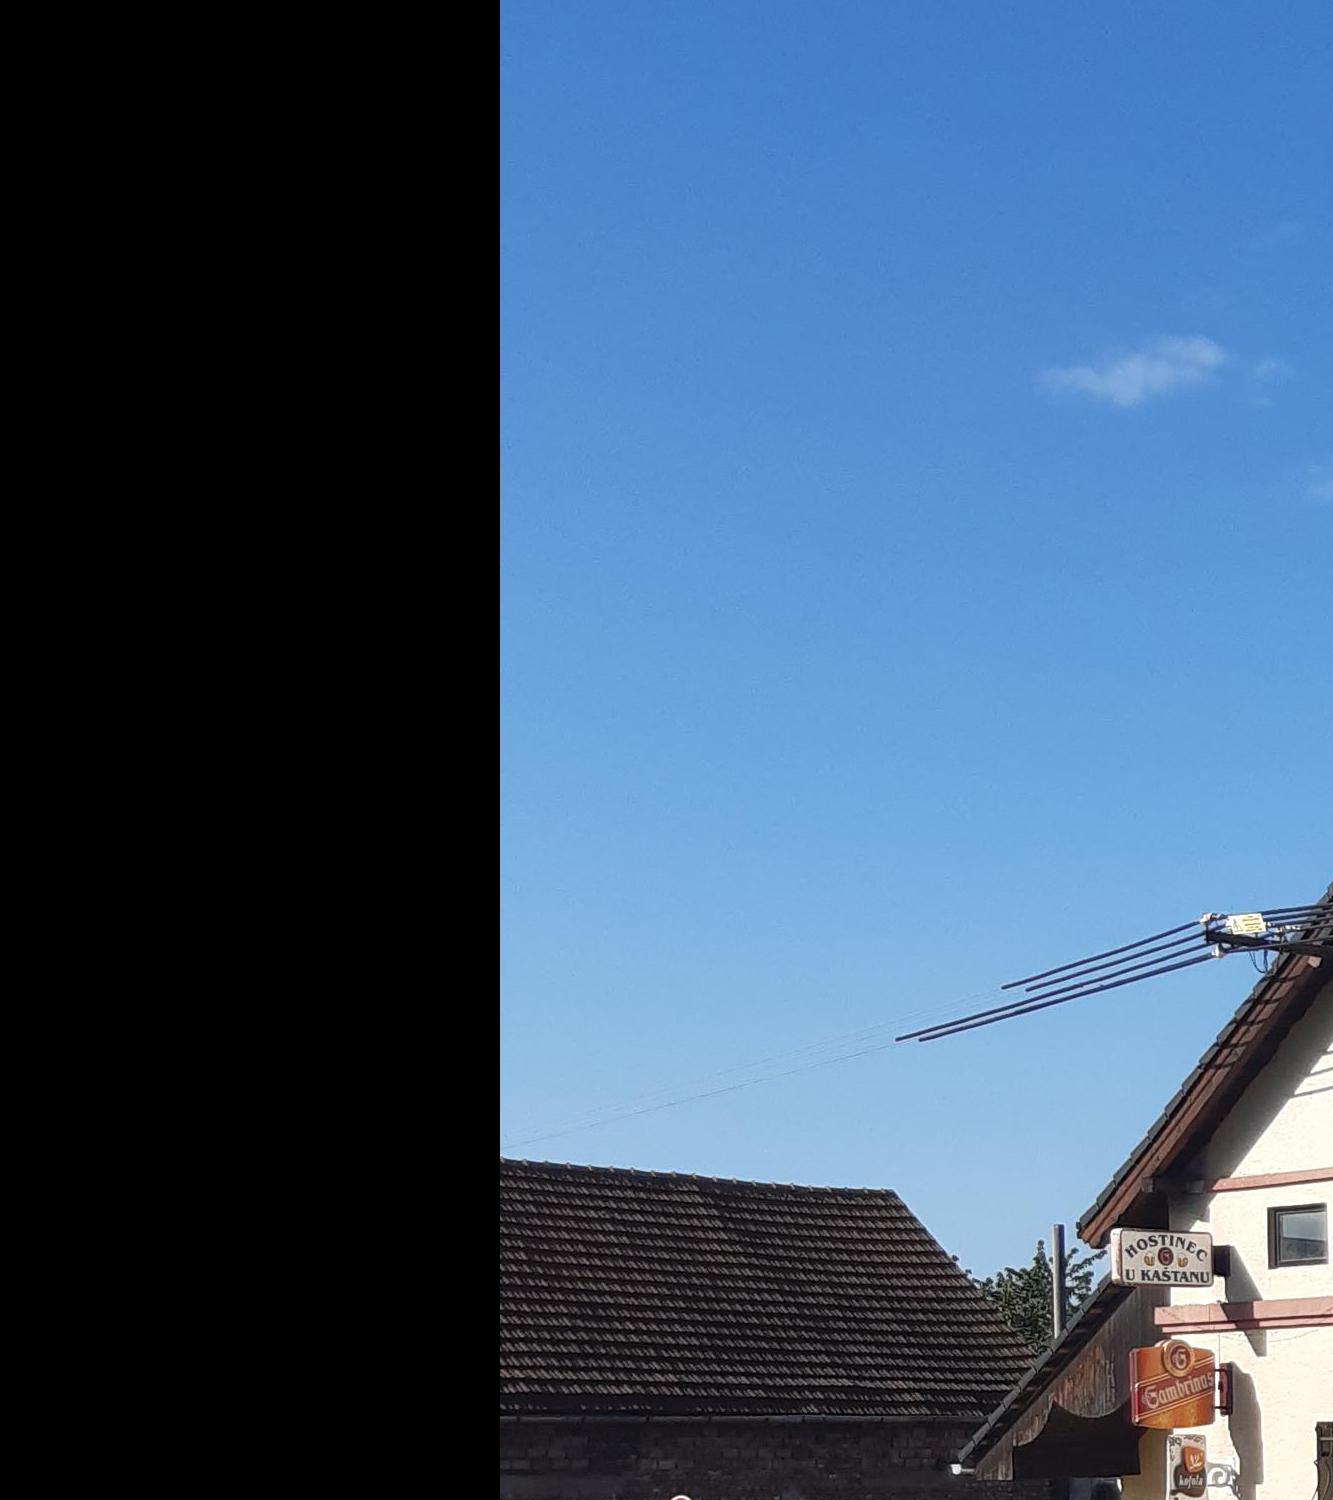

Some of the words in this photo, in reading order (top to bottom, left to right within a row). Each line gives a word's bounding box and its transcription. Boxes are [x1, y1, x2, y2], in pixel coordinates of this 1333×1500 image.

[1125, 1235, 1207, 1261] HOSTINEC
[1125, 1269, 1135, 1280] U
[1140, 1267, 1209, 1283] KAŠTANU
[1142, 1373, 1213, 1409] Gambrinus
